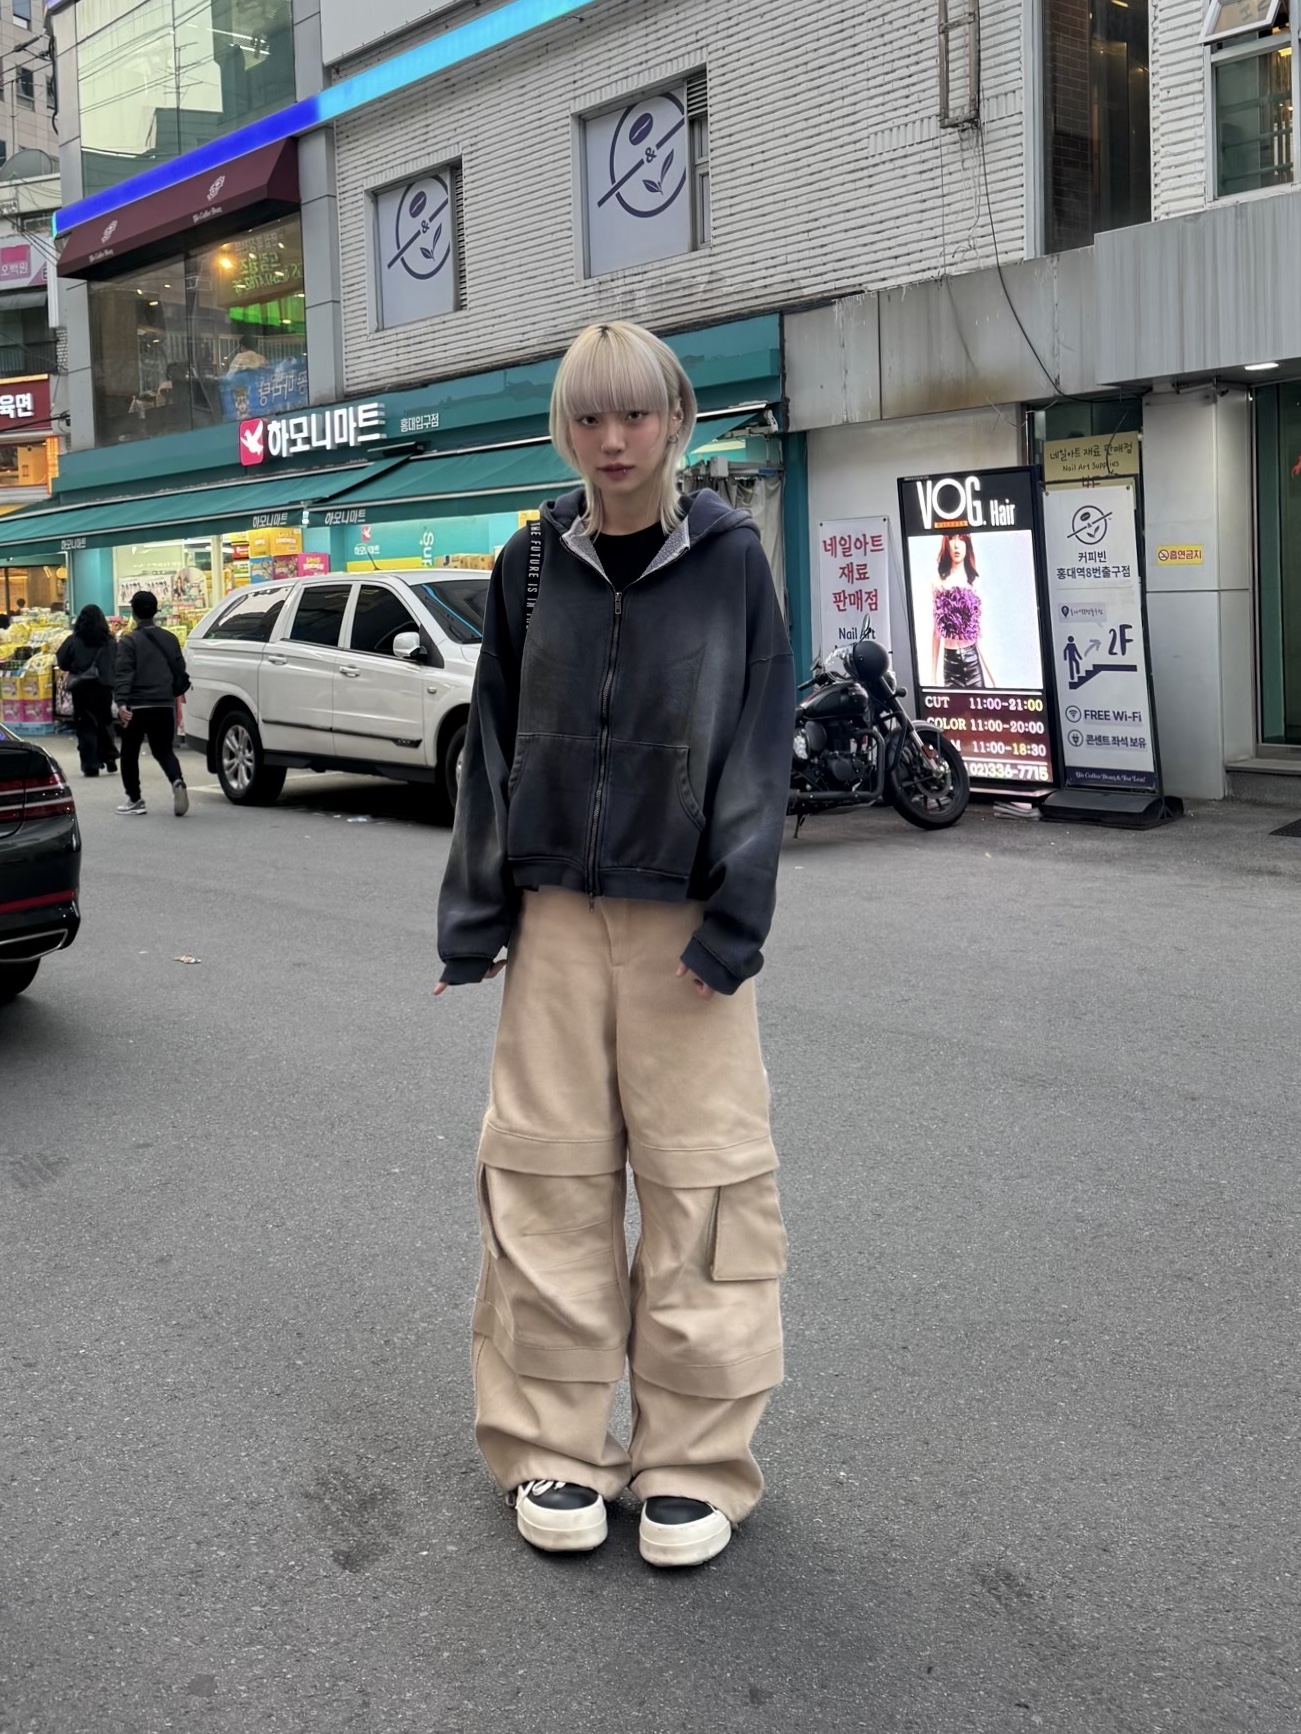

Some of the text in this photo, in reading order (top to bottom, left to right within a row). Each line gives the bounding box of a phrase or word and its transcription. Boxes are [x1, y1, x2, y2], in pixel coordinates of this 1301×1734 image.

[645, 147, 657, 163] &
[267, 402, 438, 458] 하모니마트 홍대입구점
[1050, 442, 1133, 462] 네일아트 재료 판매점
[1063, 461, 1119, 472] Nail Art Suppies
[252, 513, 288, 528] 하모니마트
[325, 509, 366, 525] 하모니마트
[989, 498, 1016, 527] Hair
[822, 534, 884, 558] 네일아트
[528, 540, 541, 578] FUTURE
[1078, 551, 1107, 563] 커피빈
[1170, 550, 1201, 560] 흡연금지
[839, 562, 870, 585] 재료
[1056, 565, 1131, 580] 홍대역8번출구점
[527, 583, 538, 593] IS
[832, 589, 878, 613] 판매점
[839, 627, 857, 640] Nail
[1108, 623, 1134, 656] 2F
[925, 695, 1043, 712] CUT 11:00-21:00
[1084, 709, 1142, 723] FREE Wi-Fi
[926, 717, 1045, 735] COLOR 11:00-20:00
[972, 741, 1047, 757] 11:00-18:30
[1086, 734, 1147, 749] 콘센트 좌석 보유
